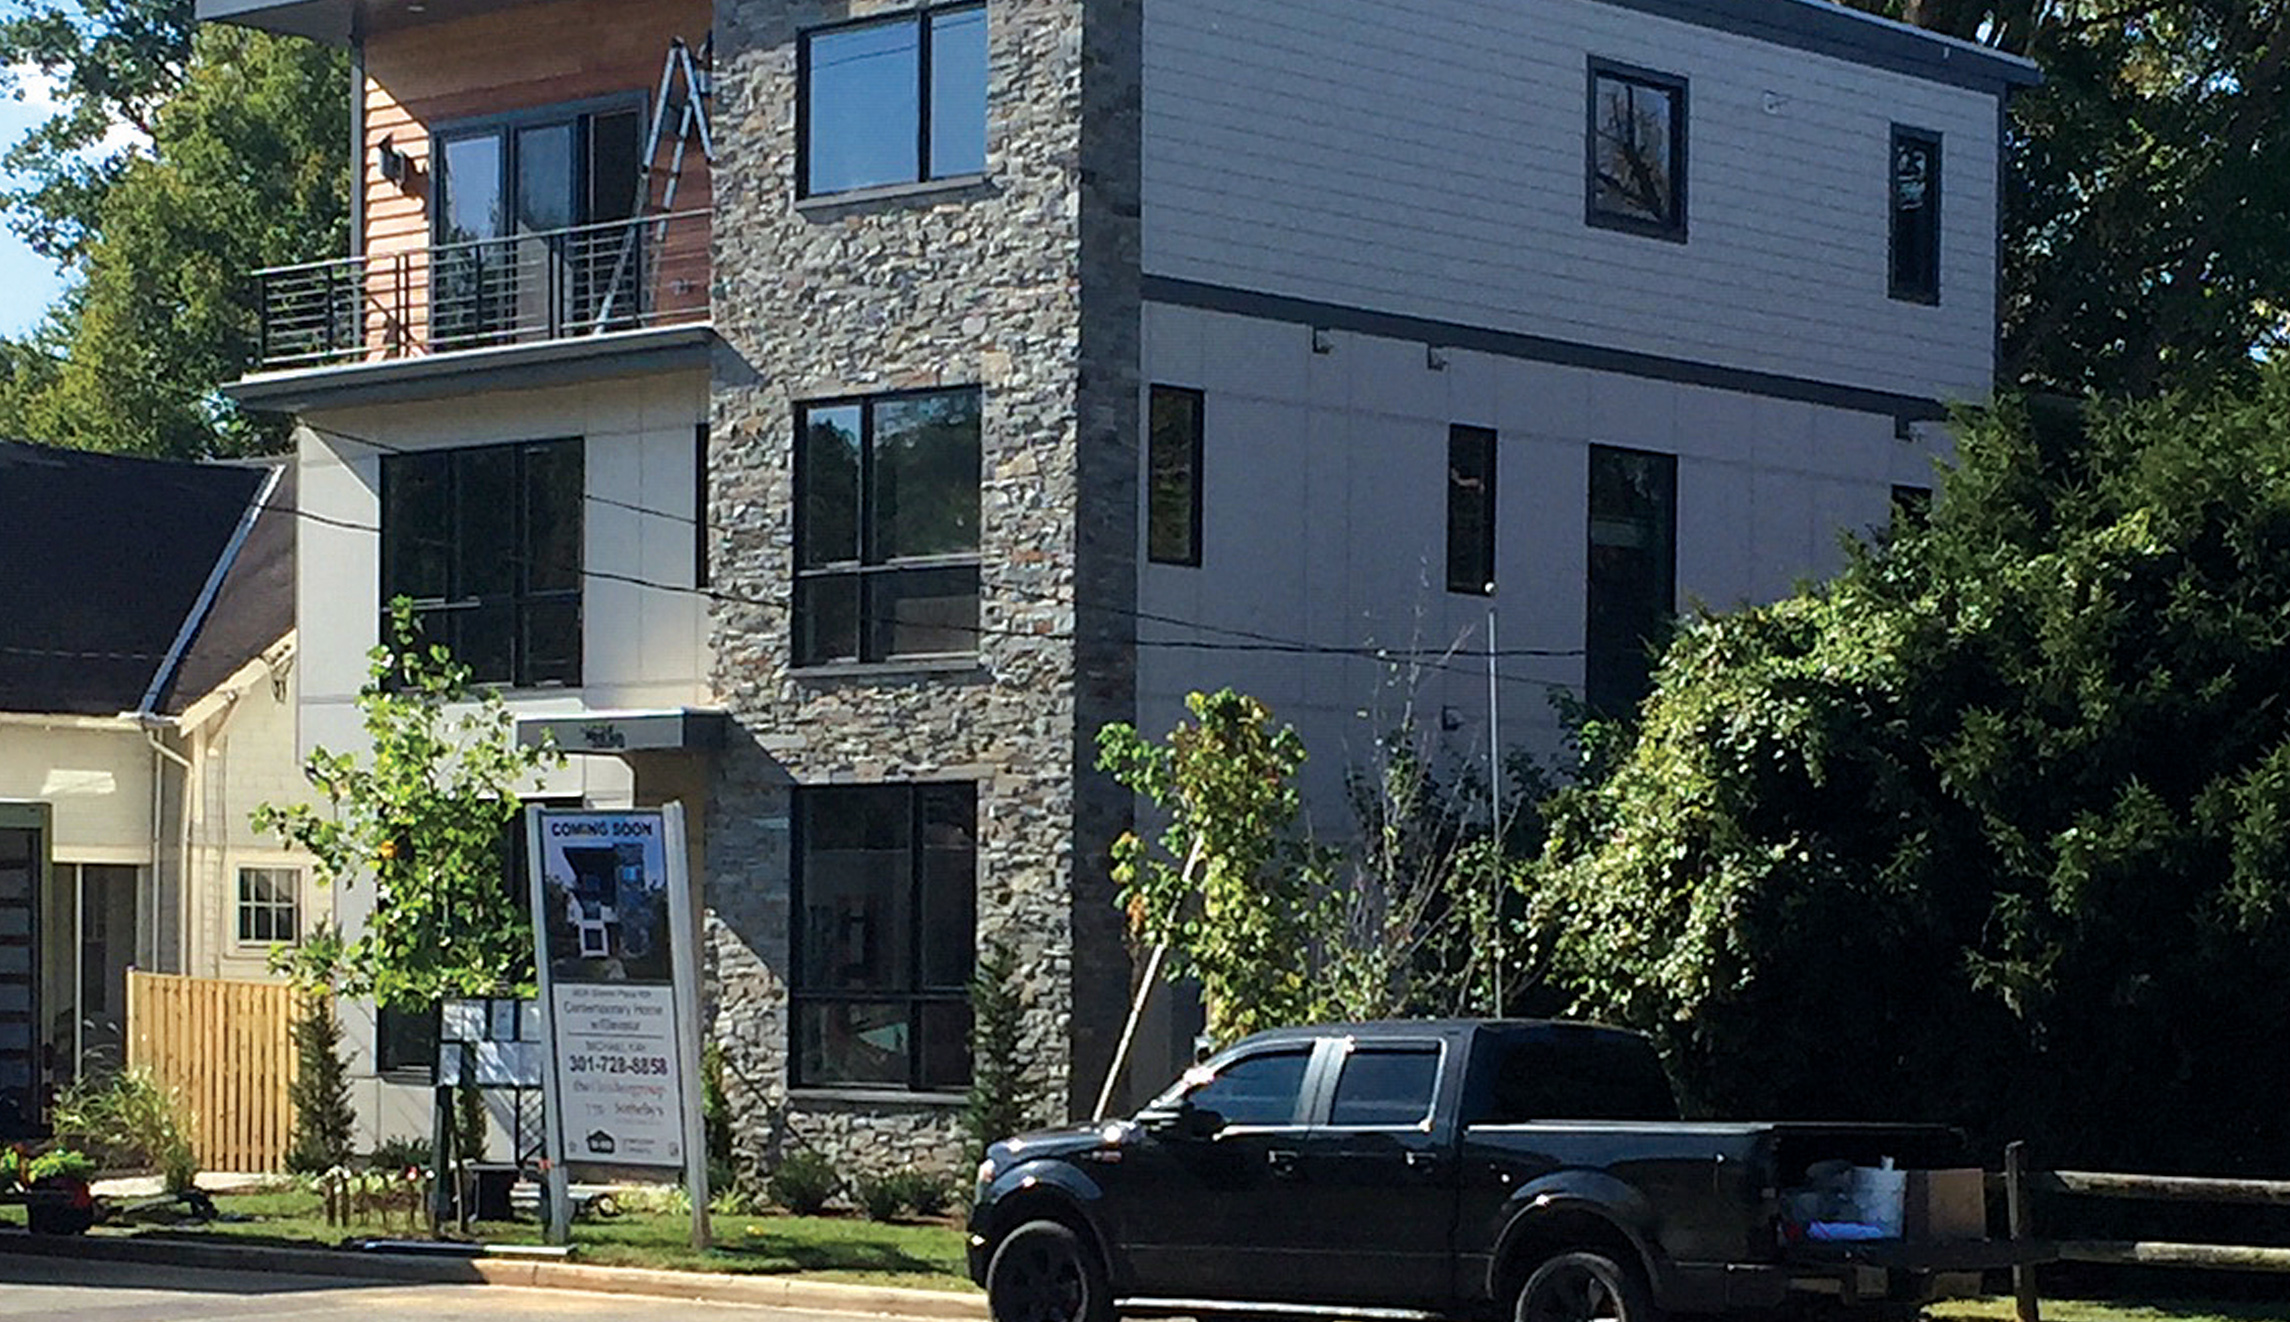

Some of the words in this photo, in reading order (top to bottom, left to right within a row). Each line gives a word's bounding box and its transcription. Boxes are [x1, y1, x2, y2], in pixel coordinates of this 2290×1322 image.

[551, 820, 609, 837] COMING
[612, 821, 653, 837] SOON
[569, 1054, 668, 1076] 301-728-8858
